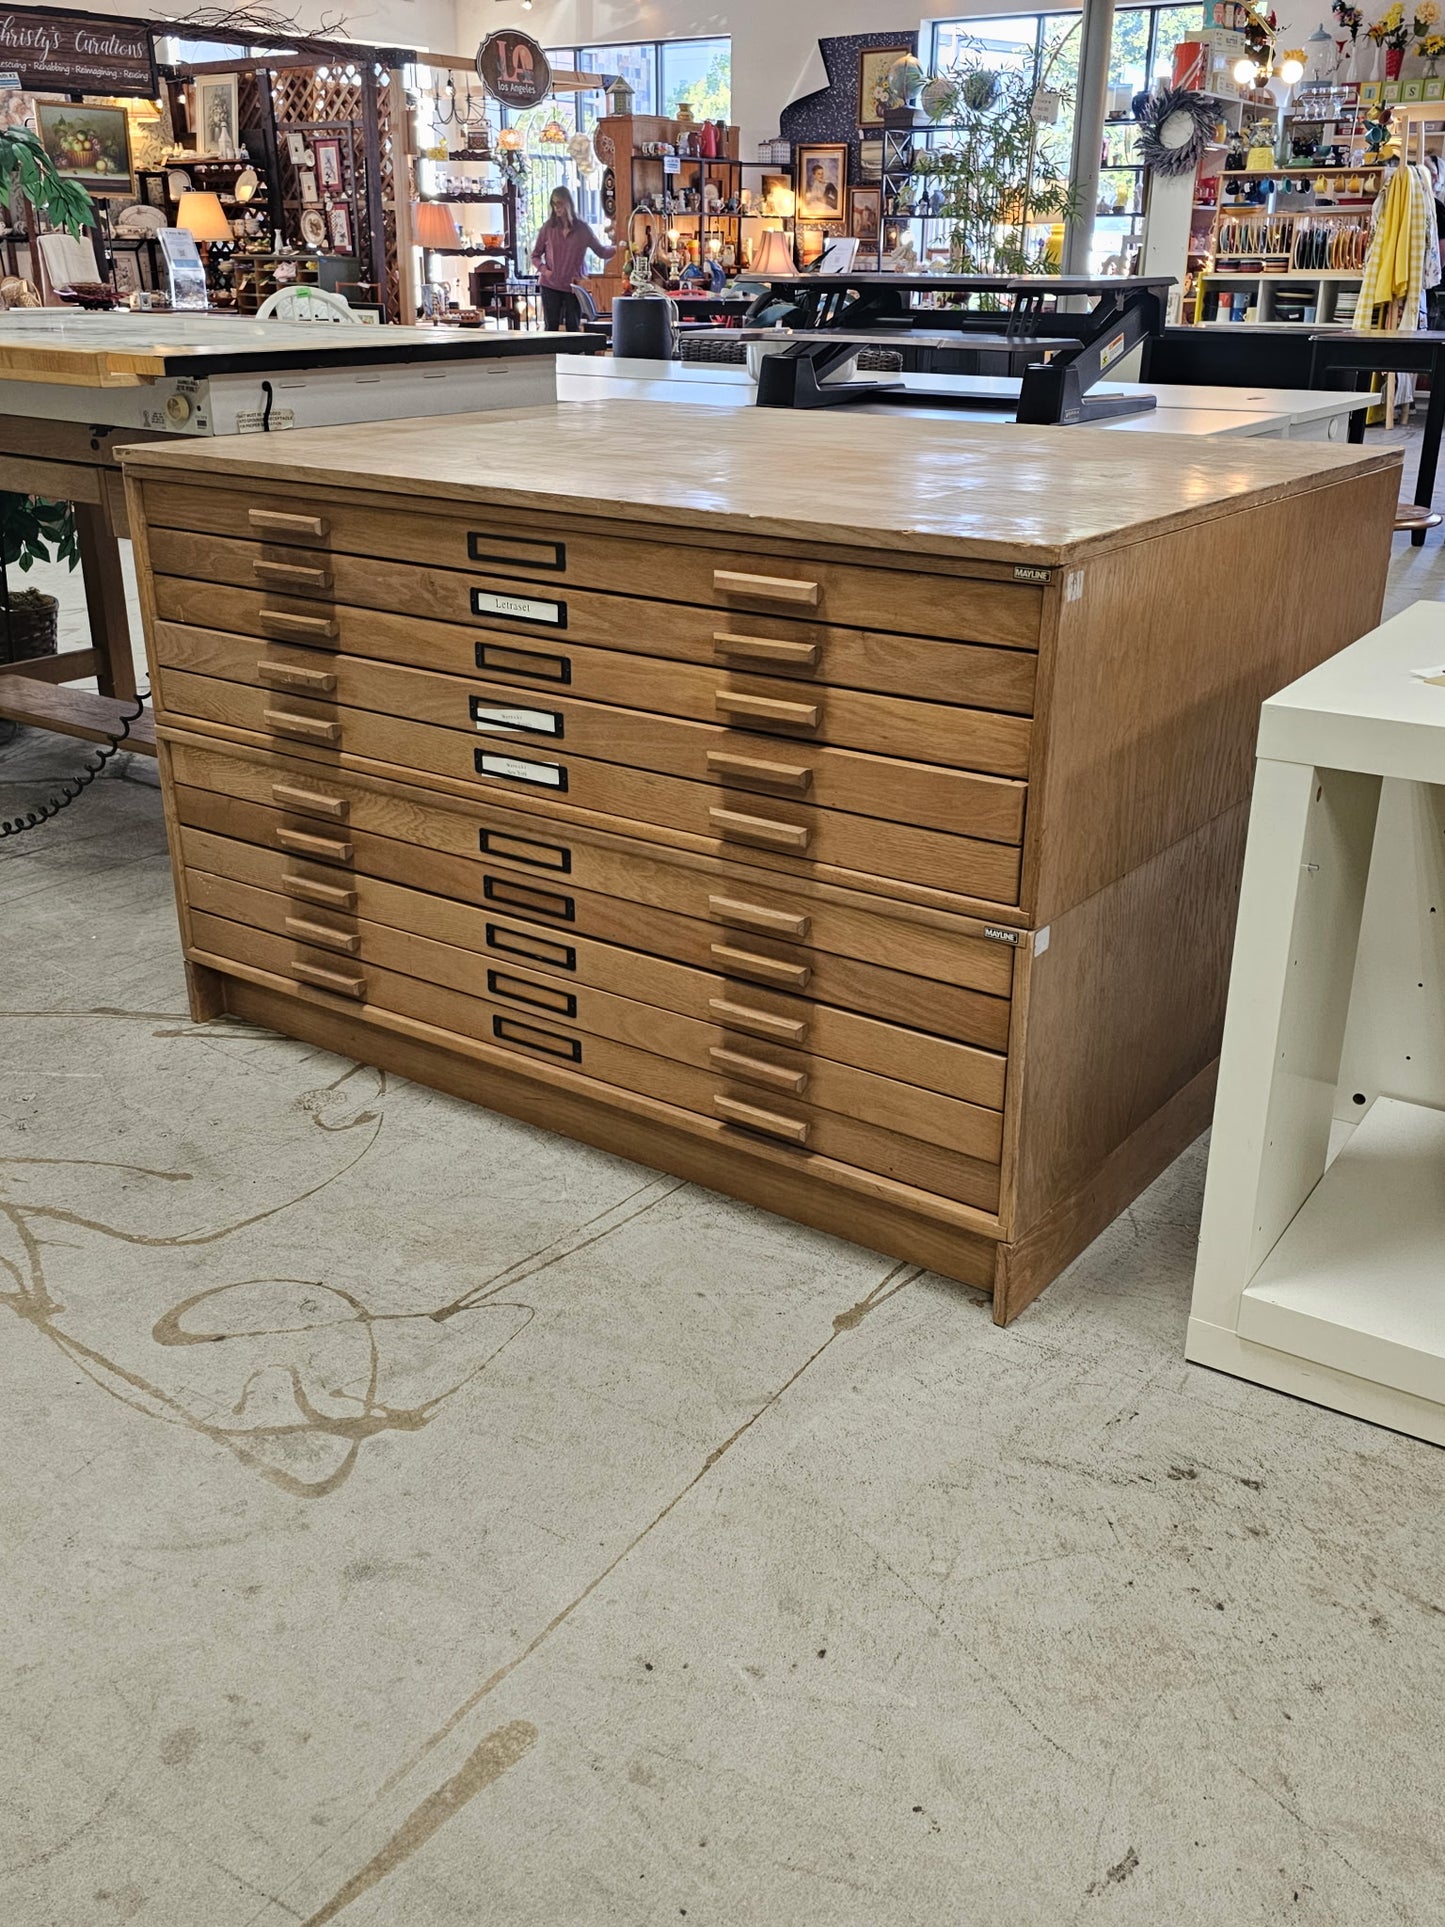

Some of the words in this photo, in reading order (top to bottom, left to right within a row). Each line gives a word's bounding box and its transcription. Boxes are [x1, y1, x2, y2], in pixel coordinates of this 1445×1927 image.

[0, 15, 62, 62] hristy's
[75, 30, 143, 58] Curations
[0, 60, 27, 72] escuing
[33, 61, 70, 75] Rehabbing
[75, 65, 118, 79] Reimagining
[123, 69, 149, 82] Reusing
[510, 83, 536, 95] Angeles
[1015, 568, 1048, 580] MAYLINE
[495, 598, 531, 612] Letraset
[985, 928, 1015, 941] MAYLINE
